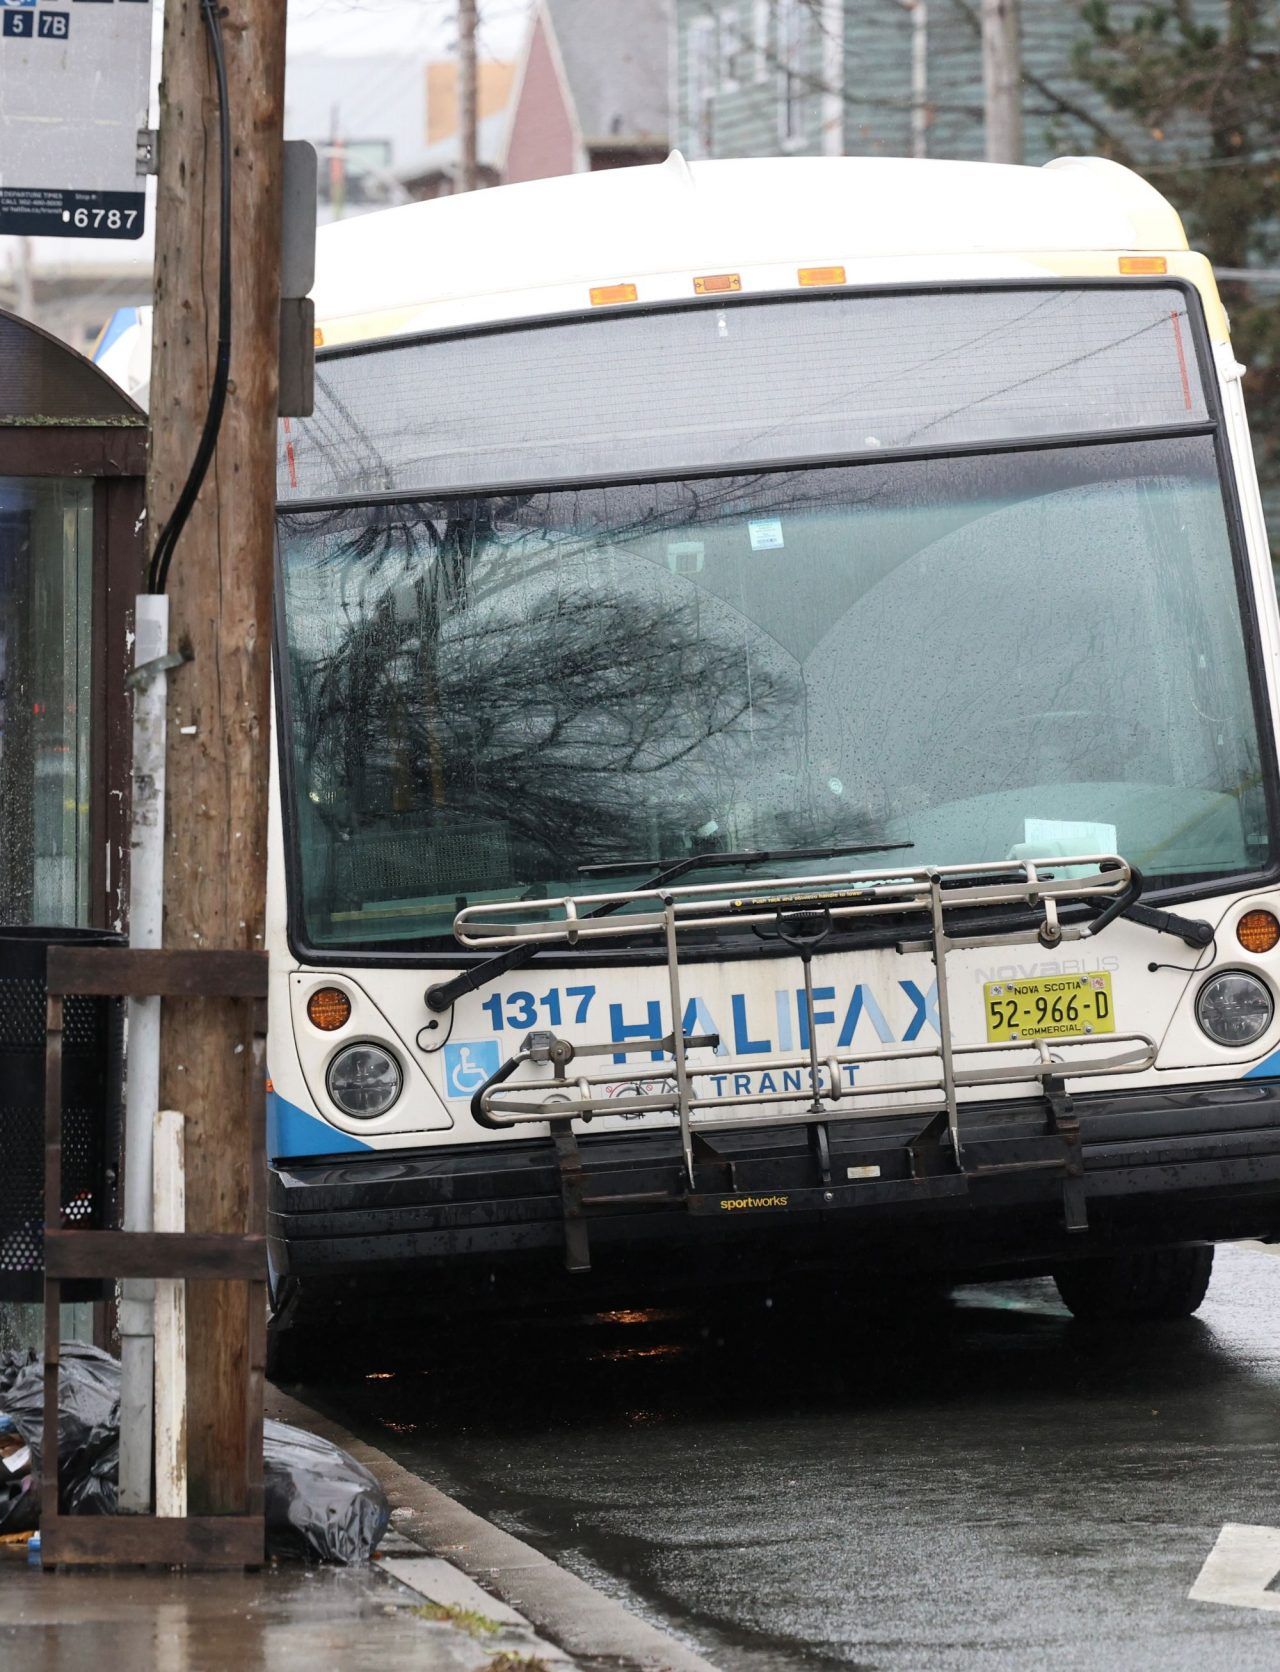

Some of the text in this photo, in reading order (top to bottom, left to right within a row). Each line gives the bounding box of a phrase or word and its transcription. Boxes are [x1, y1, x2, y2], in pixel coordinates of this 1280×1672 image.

[12, 14, 67, 36] 5 7B
[74, 208, 138, 229] 6787
[752, 897, 767, 905] Push
[819, 891, 839, 899] handle
[1014, 985, 1039, 996] NOVA
[1043, 981, 1082, 992] SCOTIA
[482, 985, 596, 1031] 1317
[990, 990, 1109, 1030] 52-966-D
[609, 979, 955, 1064] HALIFAX
[1021, 1023, 1082, 1037] COMMERCIAL
[710, 1064, 861, 1098] TRANST
[720, 1195, 787, 1211] sportworks
